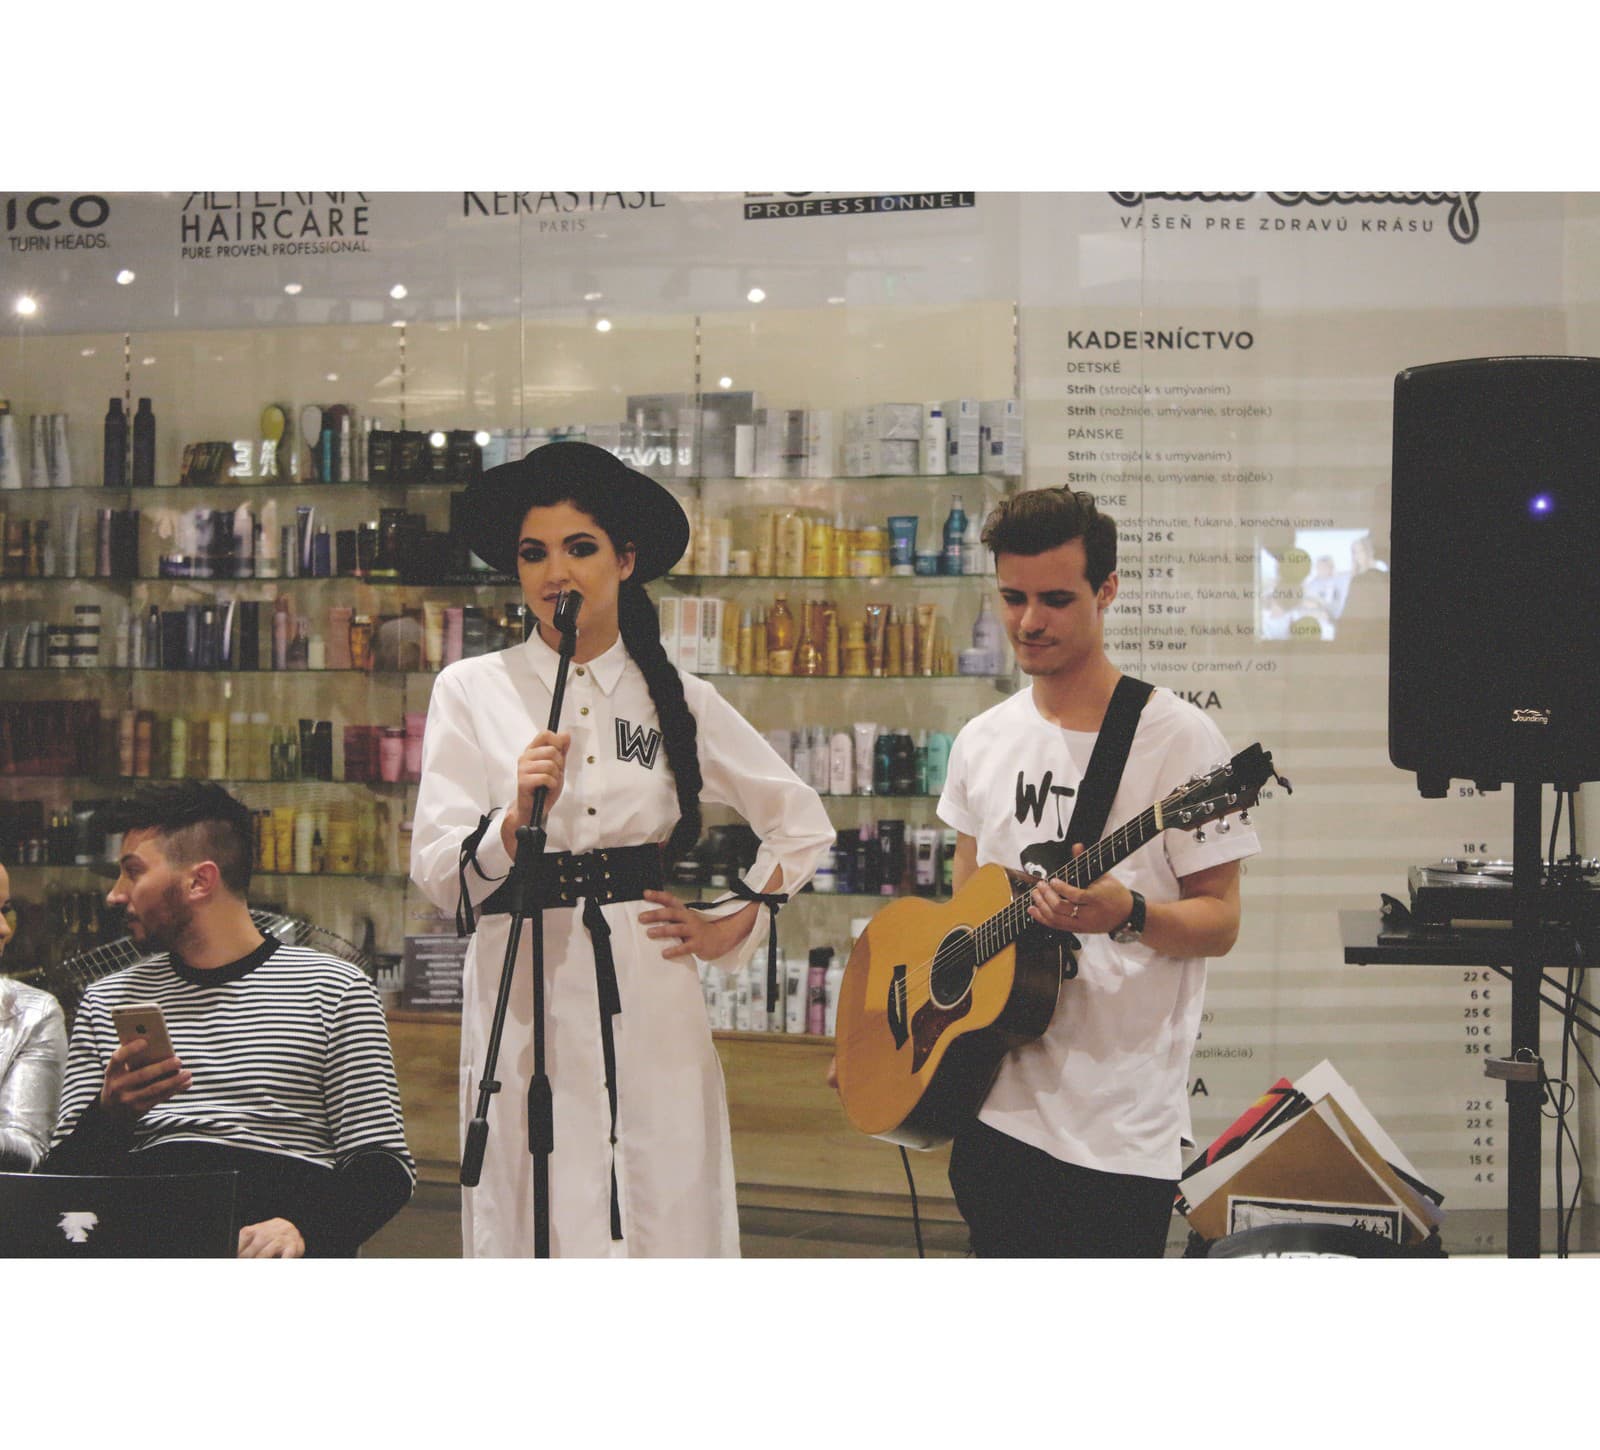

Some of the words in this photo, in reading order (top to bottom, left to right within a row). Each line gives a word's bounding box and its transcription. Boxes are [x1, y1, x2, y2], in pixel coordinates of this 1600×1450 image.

[748, 193, 971, 218] PROFESSIONNEL
[182, 207, 368, 243] HAIRCARE
[539, 219, 586, 233] PARIS
[1206, 217, 1246, 230] PRE
[8, 236, 50, 252] TURN
[1067, 325, 1254, 350] KADERNÍCTVO
[1066, 384, 1097, 395] Strih
[1066, 405, 1097, 416] Strih
[1067, 450, 1097, 461] Strih
[1067, 472, 1097, 483] Strih
[1147, 531, 1162, 542] 26
[1166, 531, 1175, 542] €
[1118, 568, 1143, 580] lasy
[1147, 568, 1163, 579] 32
[1165, 568, 1175, 579] €
[1148, 603, 1163, 615] 53
[1166, 605, 1188, 615] eur
[1148, 639, 1164, 651] 59
[1167, 641, 1188, 651] eur
[1255, 660, 1277, 673] od)
[615, 717, 663, 770] W
[1459, 788, 1474, 798] 59
[1464, 843, 1475, 854] 18
[1480, 843, 1487, 854] €
[1463, 971, 1478, 982] 22
[1482, 971, 1490, 982] €
[1471, 989, 1478, 1000] 6
[1482, 989, 1491, 1000] €
[1464, 1007, 1479, 1018] 25
[1483, 1007, 1491, 1018] €
[1466, 1025, 1479, 1036] 10
[1483, 1025, 1491, 1036] €
[1465, 1043, 1480, 1055] 35
[1483, 1043, 1491, 1055] €
[1466, 1100, 1481, 1111] 22
[1485, 1100, 1493, 1111] €
[1466, 1118, 1481, 1129] 22
[1485, 1118, 1493, 1129] €
[1473, 1136, 1481, 1147] 4
[1486, 1136, 1494, 1147] €
[1469, 1154, 1482, 1165] 15
[1486, 1154, 1494, 1165] €
[1474, 1172, 1482, 1183] 4
[1487, 1172, 1494, 1183] €
